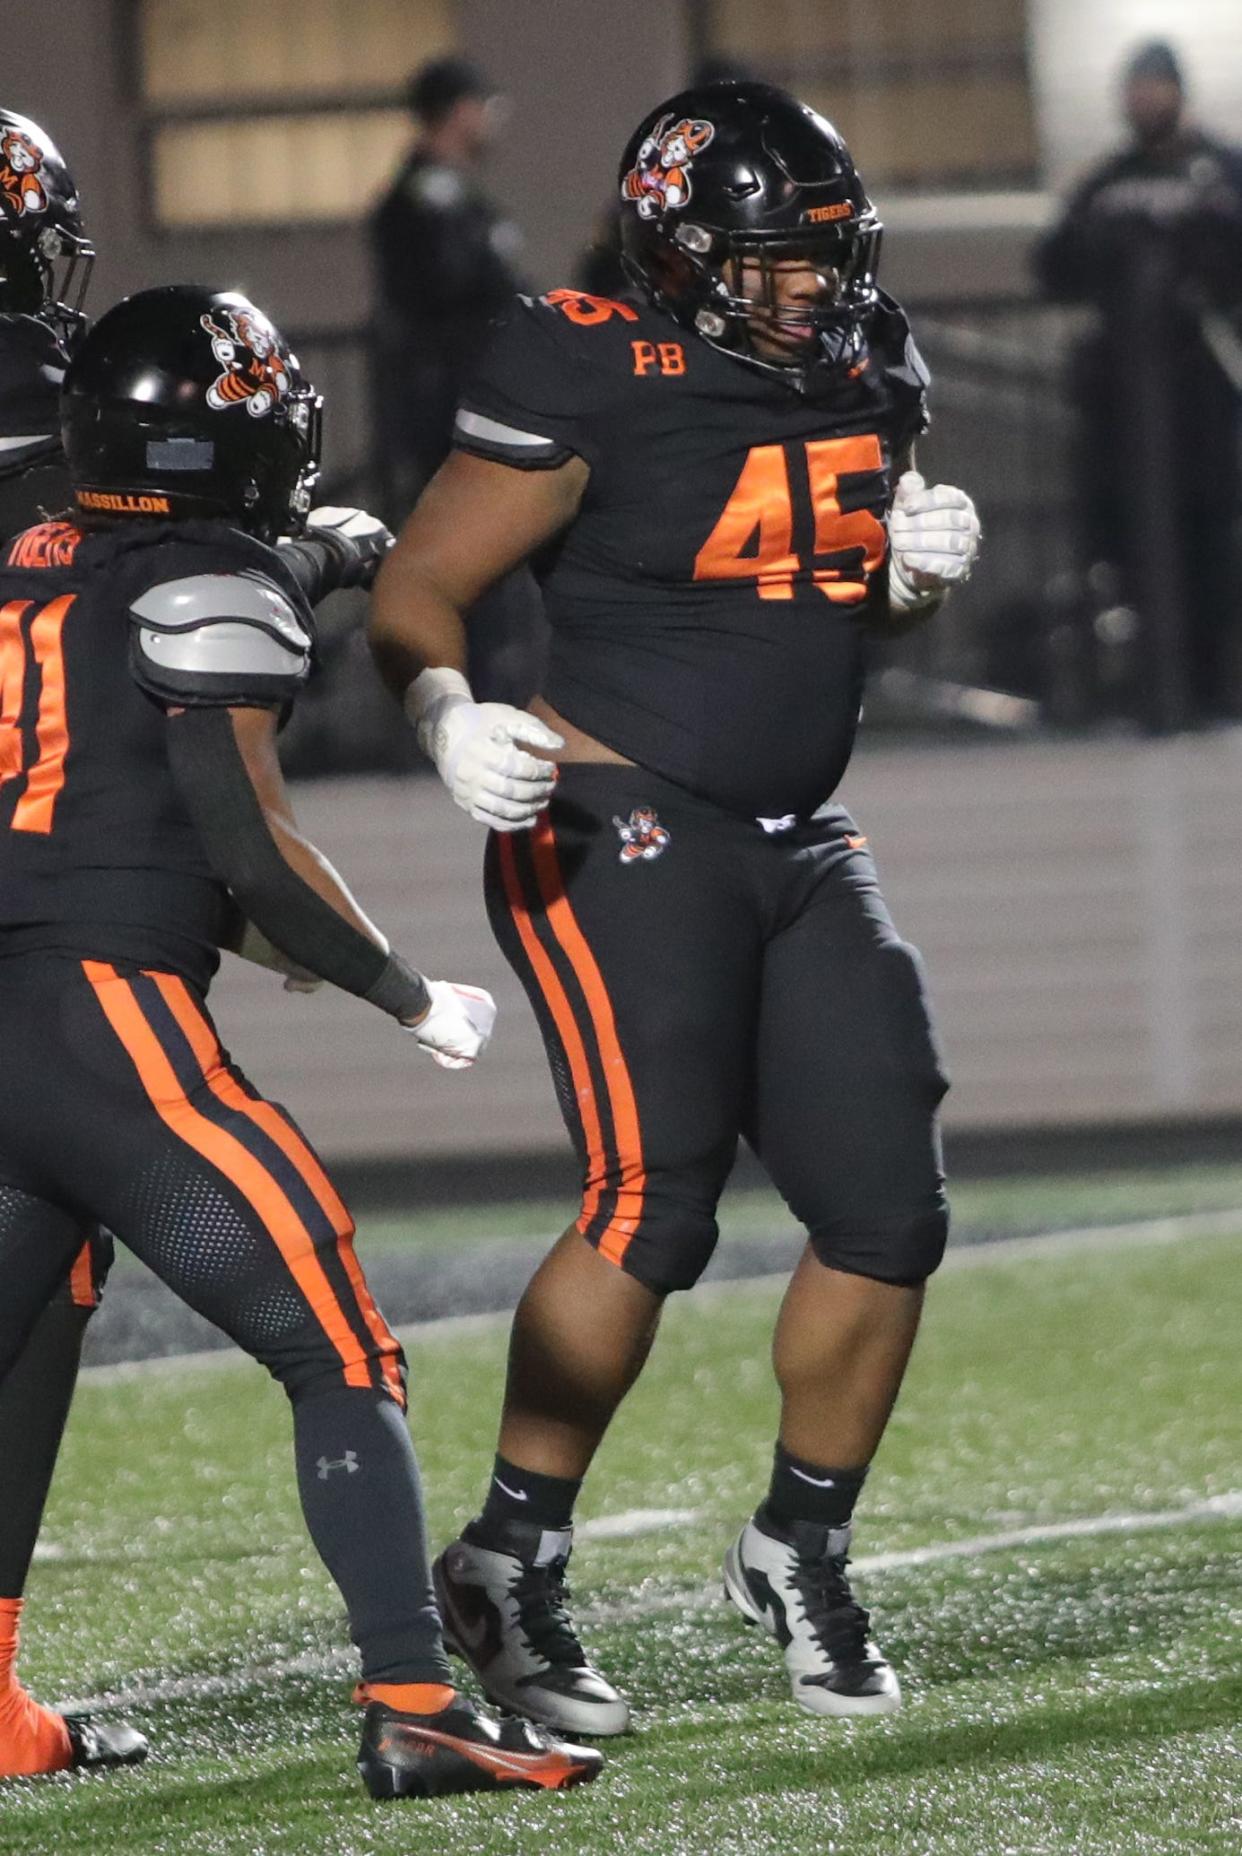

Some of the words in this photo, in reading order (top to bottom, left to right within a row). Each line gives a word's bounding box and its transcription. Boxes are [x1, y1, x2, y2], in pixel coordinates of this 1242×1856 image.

[808, 202, 851, 223] TIGERS
[630, 340, 686, 376] PB
[692, 434, 886, 604] 45
